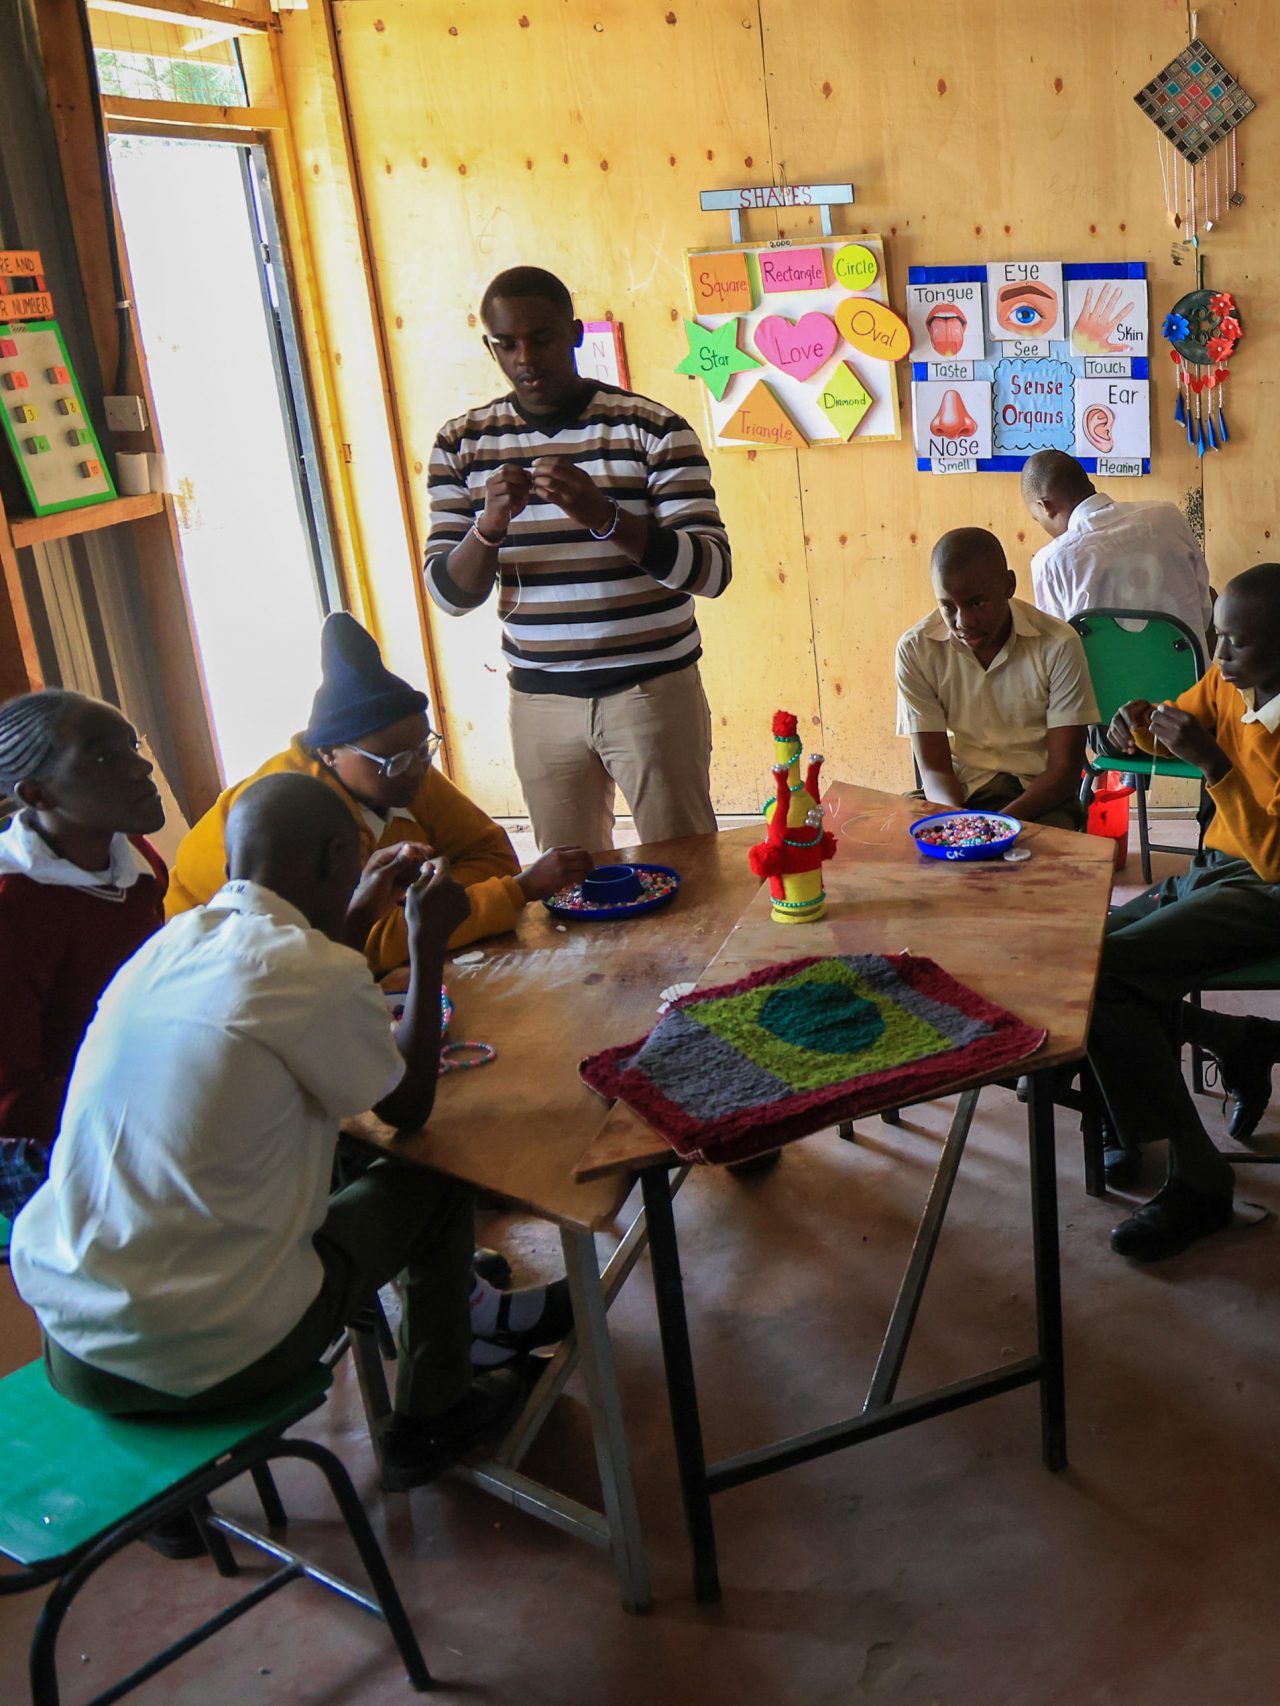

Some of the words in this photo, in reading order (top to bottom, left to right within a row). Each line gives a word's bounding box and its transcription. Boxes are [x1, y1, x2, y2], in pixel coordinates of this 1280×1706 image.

[740, 185, 812, 208] SHAPES
[15, 257, 35, 272] AND
[763, 261, 822, 286] Rectangle
[836, 258, 875, 276] Circle
[700, 272, 747, 301] Square
[914, 287, 974, 303] Tongue
[12, 296, 50, 315] NUMBER
[851, 310, 897, 348] Oval
[1116, 324, 1144, 341] Skin
[775, 337, 823, 366] Love
[1014, 342, 1039, 357] See
[700, 347, 730, 371] Star
[1086, 360, 1126, 375] Touch
[931, 363, 968, 378] Taste
[1010, 374, 1064, 396] Sense
[823, 392, 866, 409] Diamond
[1108, 384, 1140, 405] Ear
[26, 409, 35, 421] 3
[1002, 403, 1064, 433] Organs
[738, 411, 793, 441] Triangle
[938, 458, 970, 473] Smell
[1099, 458, 1140, 475] Hearing
